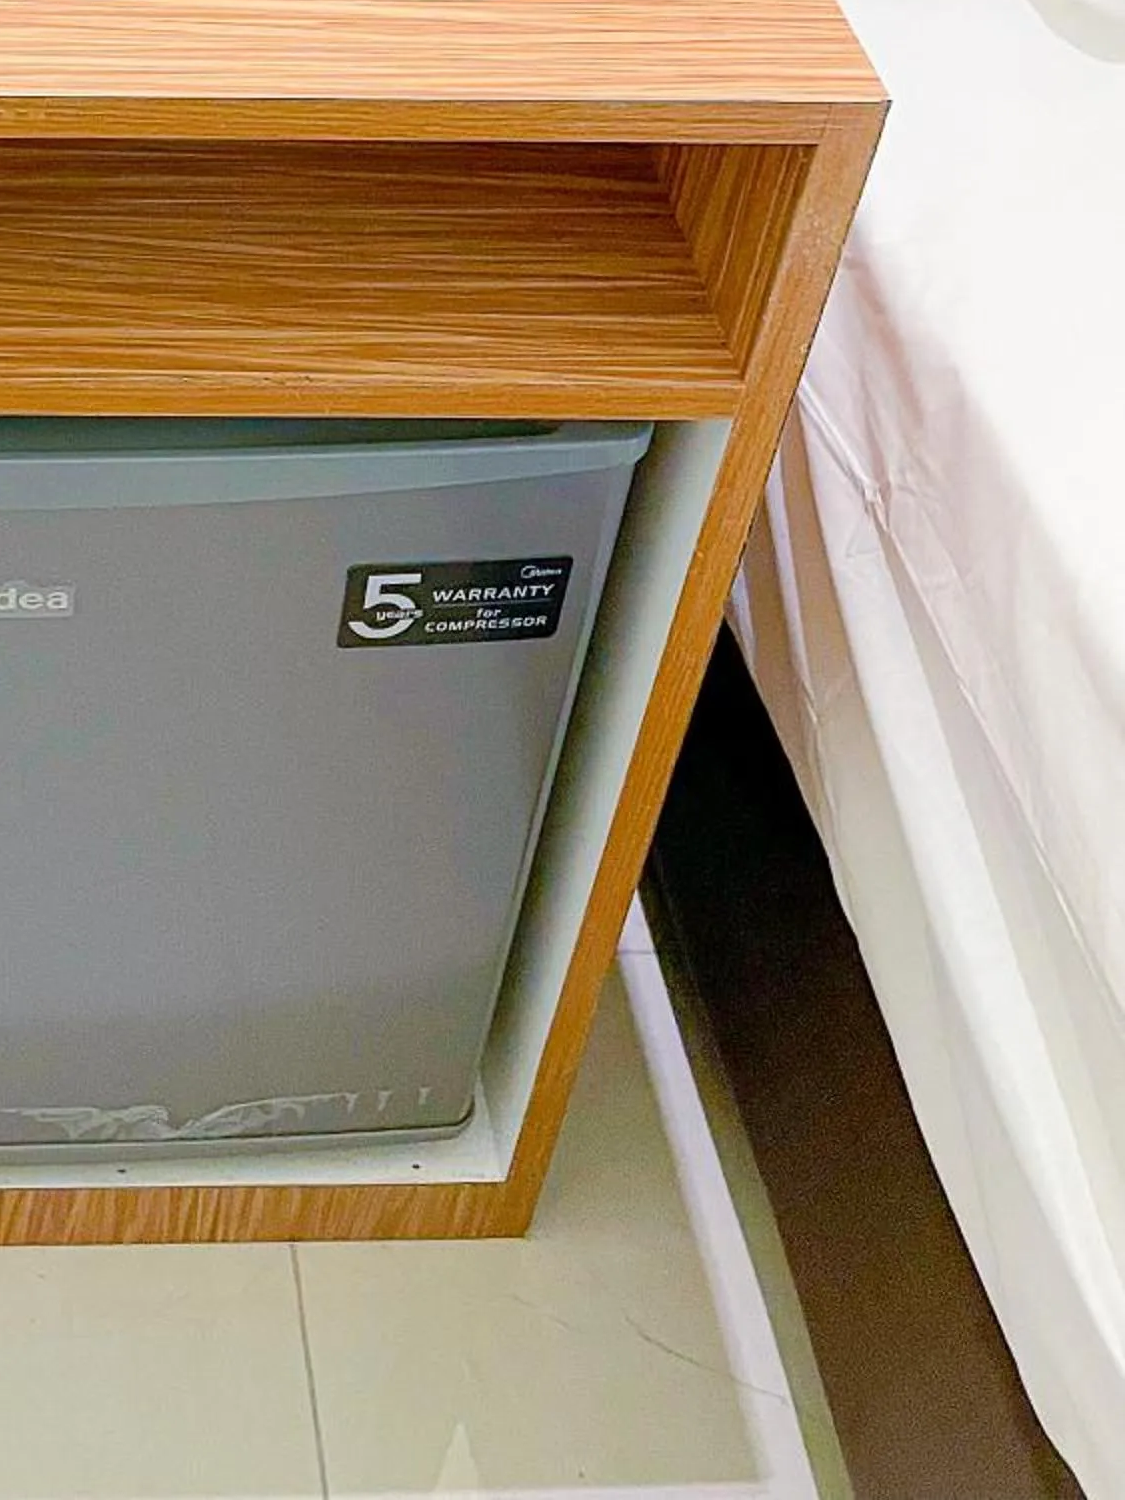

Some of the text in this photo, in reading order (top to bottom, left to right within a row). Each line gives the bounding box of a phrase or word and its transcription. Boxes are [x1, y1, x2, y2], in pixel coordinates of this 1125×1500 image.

[432, 583, 556, 602] WARRANTY
[348, 573, 422, 639] 5
[376, 609, 424, 621] years
[476, 607, 502, 619] for
[424, 615, 548, 633] COMPRESSOR
